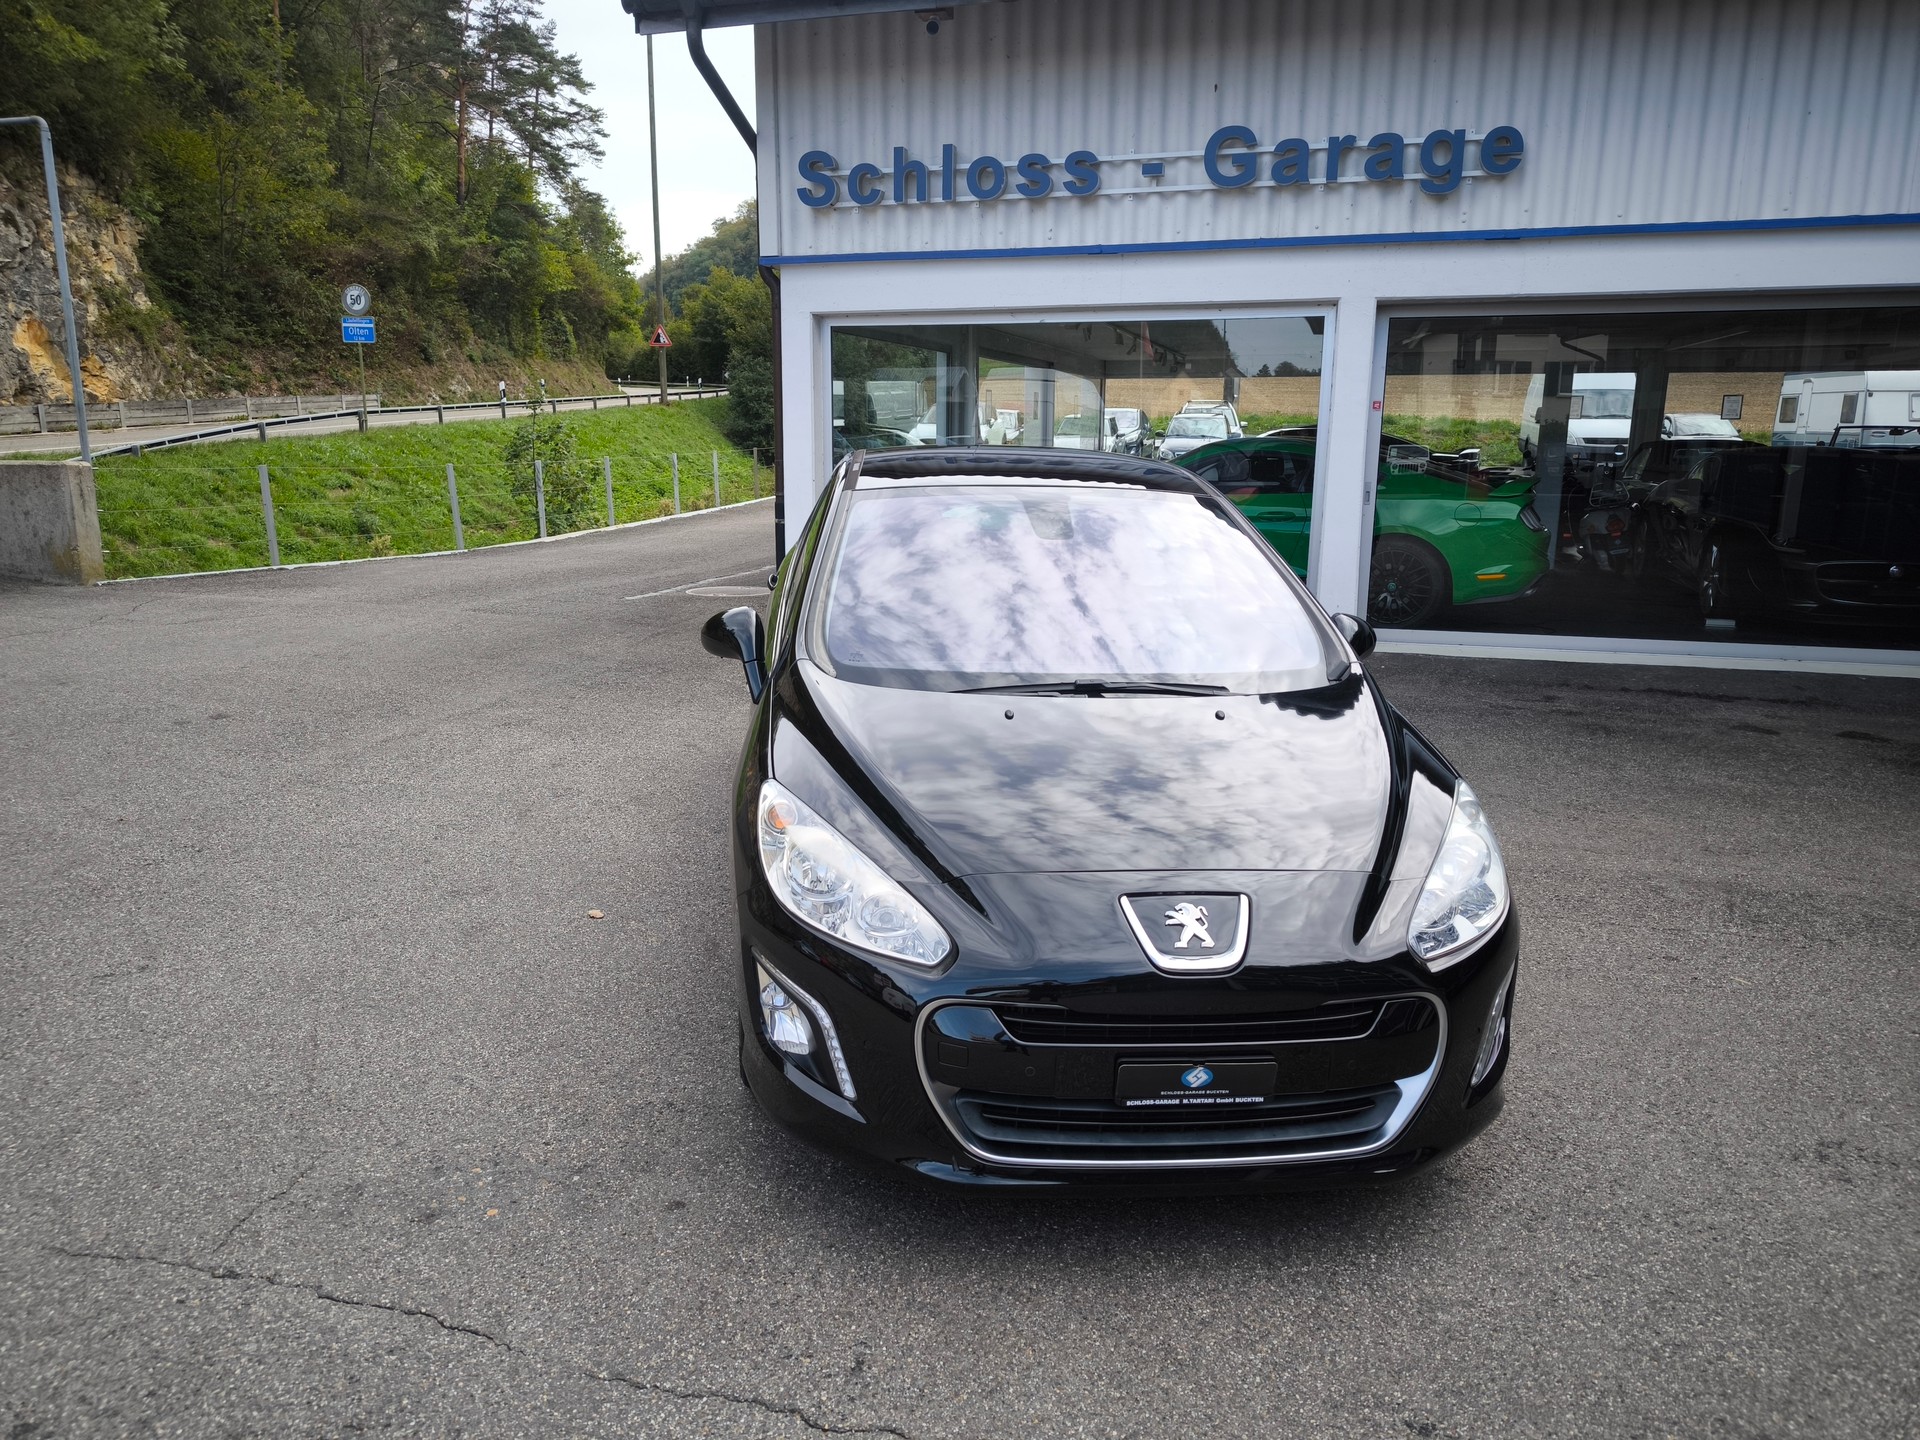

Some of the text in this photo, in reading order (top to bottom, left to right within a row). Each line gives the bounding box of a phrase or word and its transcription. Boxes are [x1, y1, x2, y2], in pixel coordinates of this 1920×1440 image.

[796, 143, 1101, 208] Schloss
[1202, 124, 1525, 195] Garage
[350, 294, 361, 305] 50
[348, 327, 369, 335] Olten
[1126, 1098, 1180, 1106] SCHLOSS-GARAGE
